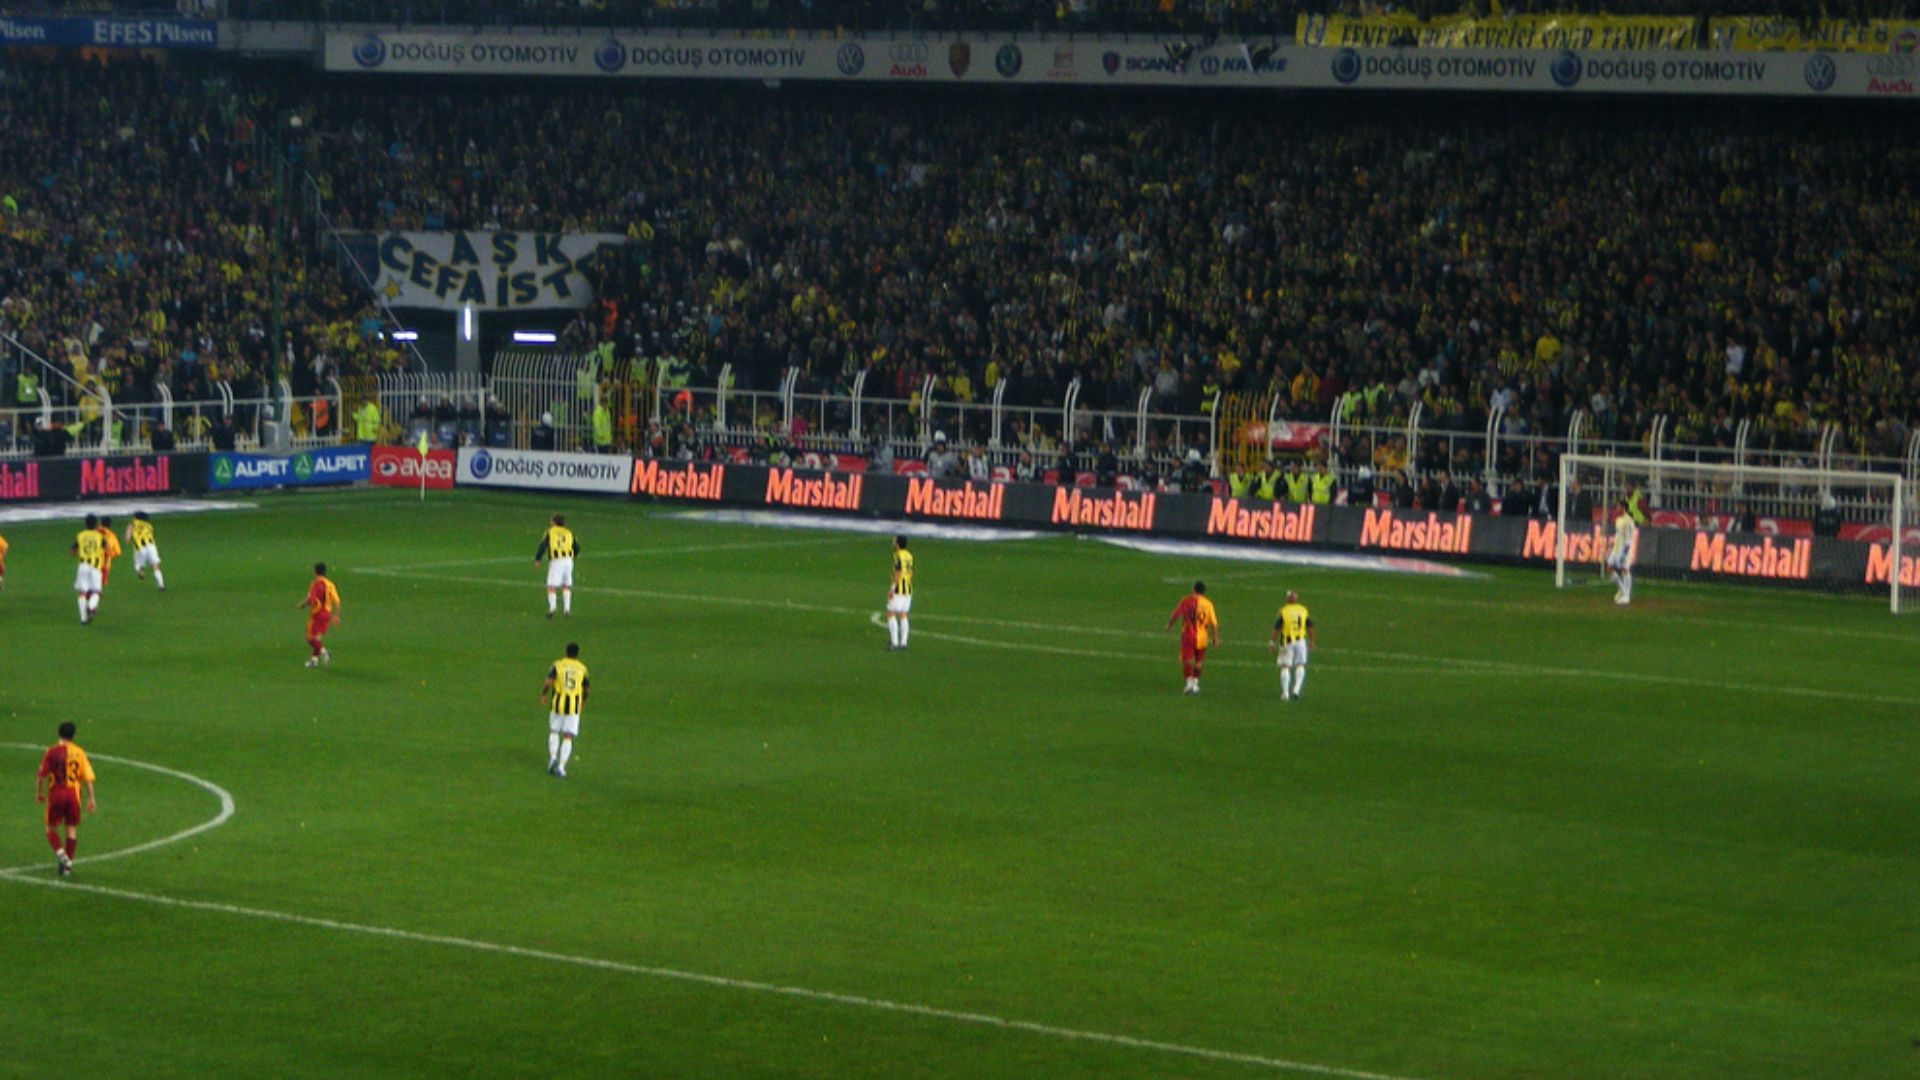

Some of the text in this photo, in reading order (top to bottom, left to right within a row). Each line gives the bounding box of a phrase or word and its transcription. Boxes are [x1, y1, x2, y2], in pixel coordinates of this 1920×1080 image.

[94, 19, 214, 44] EFES Pilsen
[393, 44, 578, 64] DOĞUŞ OTOMOTİV
[633, 46, 806, 67] DOĞUŞ OTOMOTİV
[1126, 56, 1188, 72] SCAN
[889, 63, 928, 77] Audi
[1366, 56, 1536, 80] DOĞUŞ OTOMOTİV
[1587, 59, 1766, 83] DOĞUŞ OTOMOTİV
[1866, 78, 1914, 93] Audi
[381, 235, 487, 305] CEFA
[80, 456, 169, 495] Marshall
[234, 458, 290, 477] ALPET
[314, 454, 367, 473] ALPET
[400, 457, 452, 479] avea
[495, 458, 621, 481] DOĞUŞ OTOMOTİV
[0, 462, 39, 498] hall
[631, 457, 725, 500] Marshall
[765, 468, 863, 510] Marshall
[905, 477, 1004, 520] Marshall
[1051, 486, 1156, 530] Marshall
[1207, 497, 1316, 543] Marshall
[1360, 507, 1472, 554] Marshall
[1691, 531, 1812, 580] Marshall
